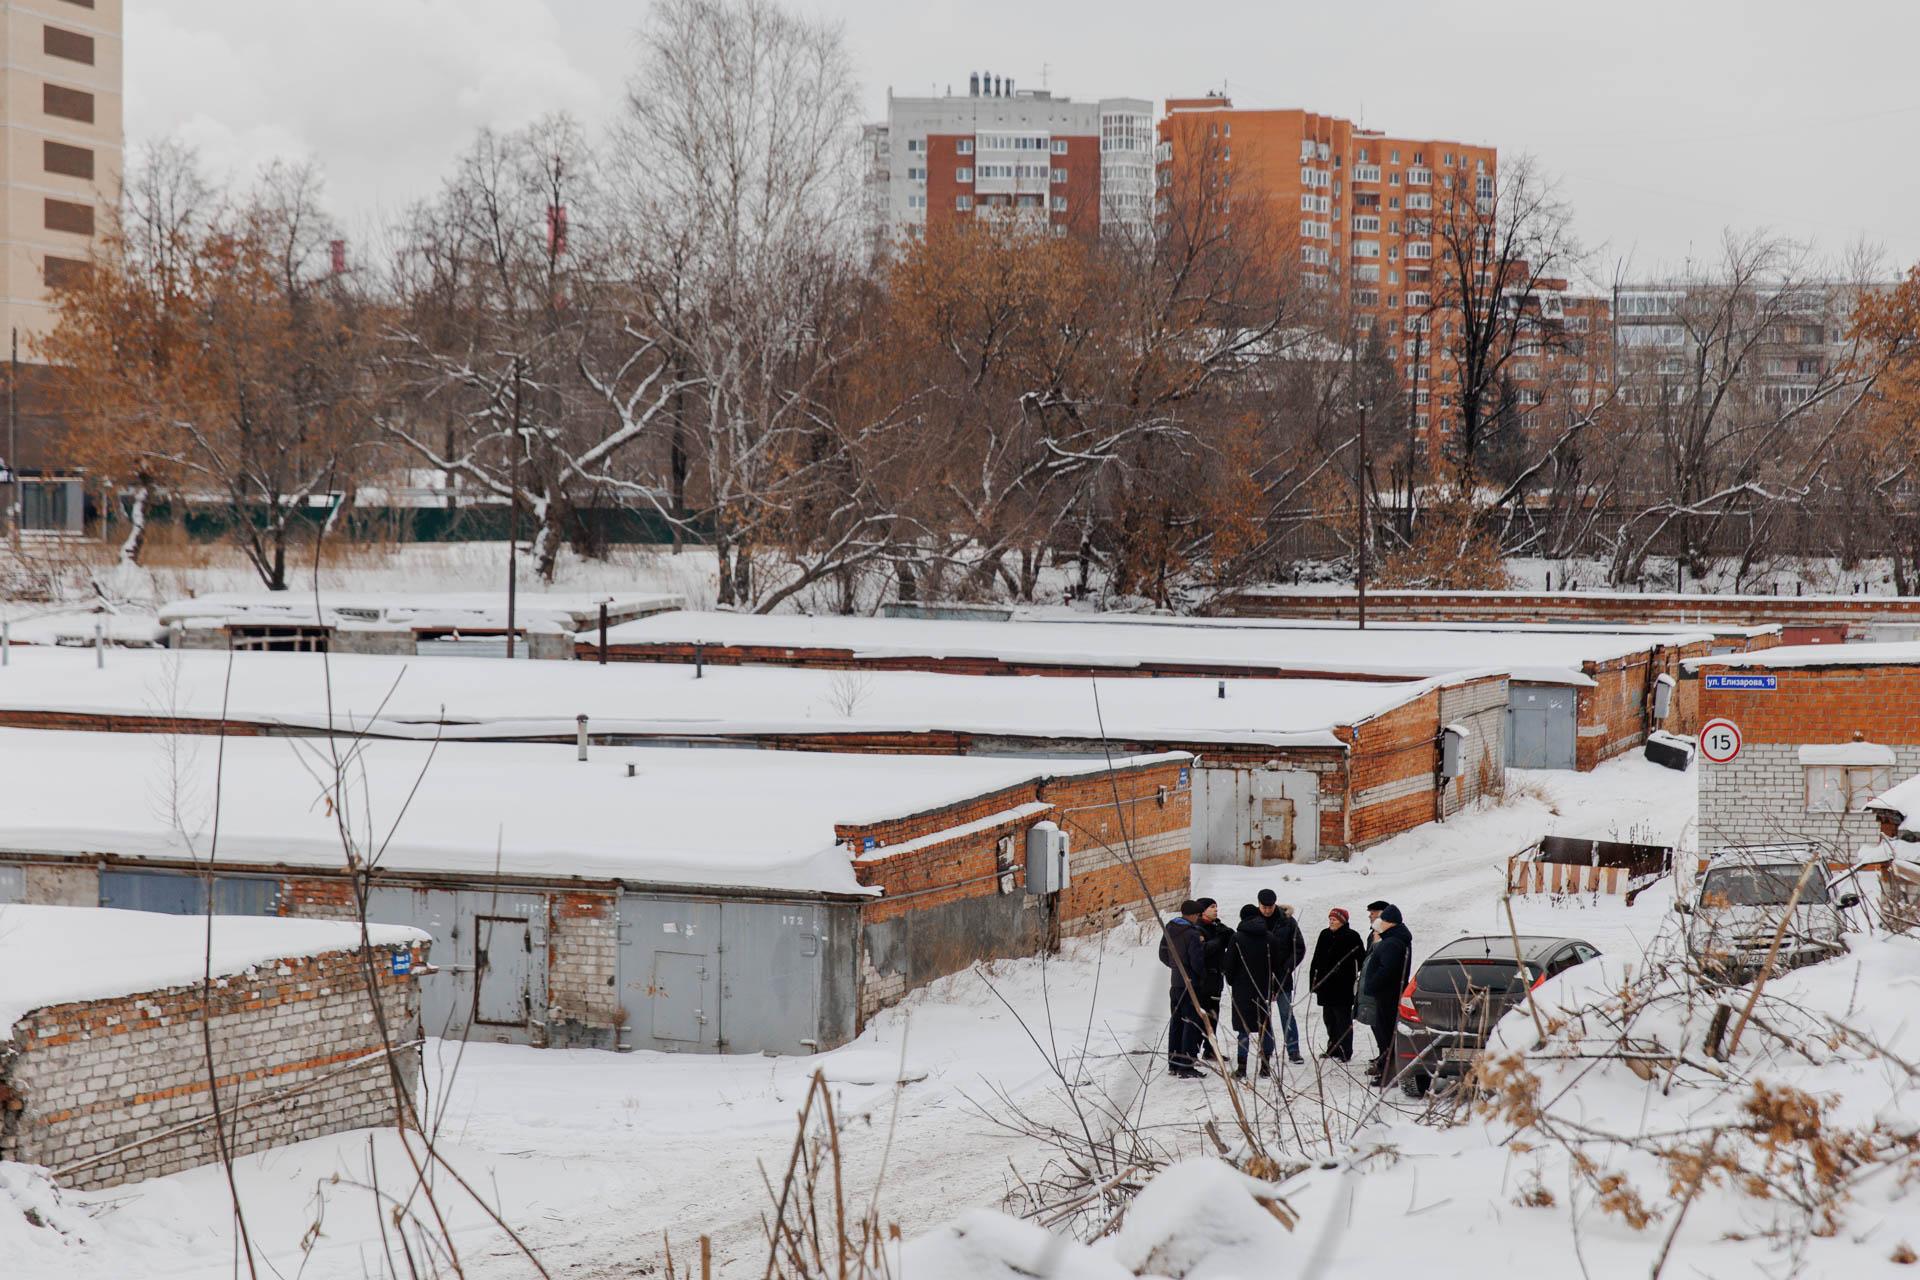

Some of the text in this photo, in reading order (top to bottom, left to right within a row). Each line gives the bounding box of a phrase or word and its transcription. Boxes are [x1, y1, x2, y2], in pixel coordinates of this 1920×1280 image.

[1707, 677, 1775, 688] ул. Елизарова, 19
[1711, 734, 1731, 750] 15
[782, 915, 804, 925] 172
